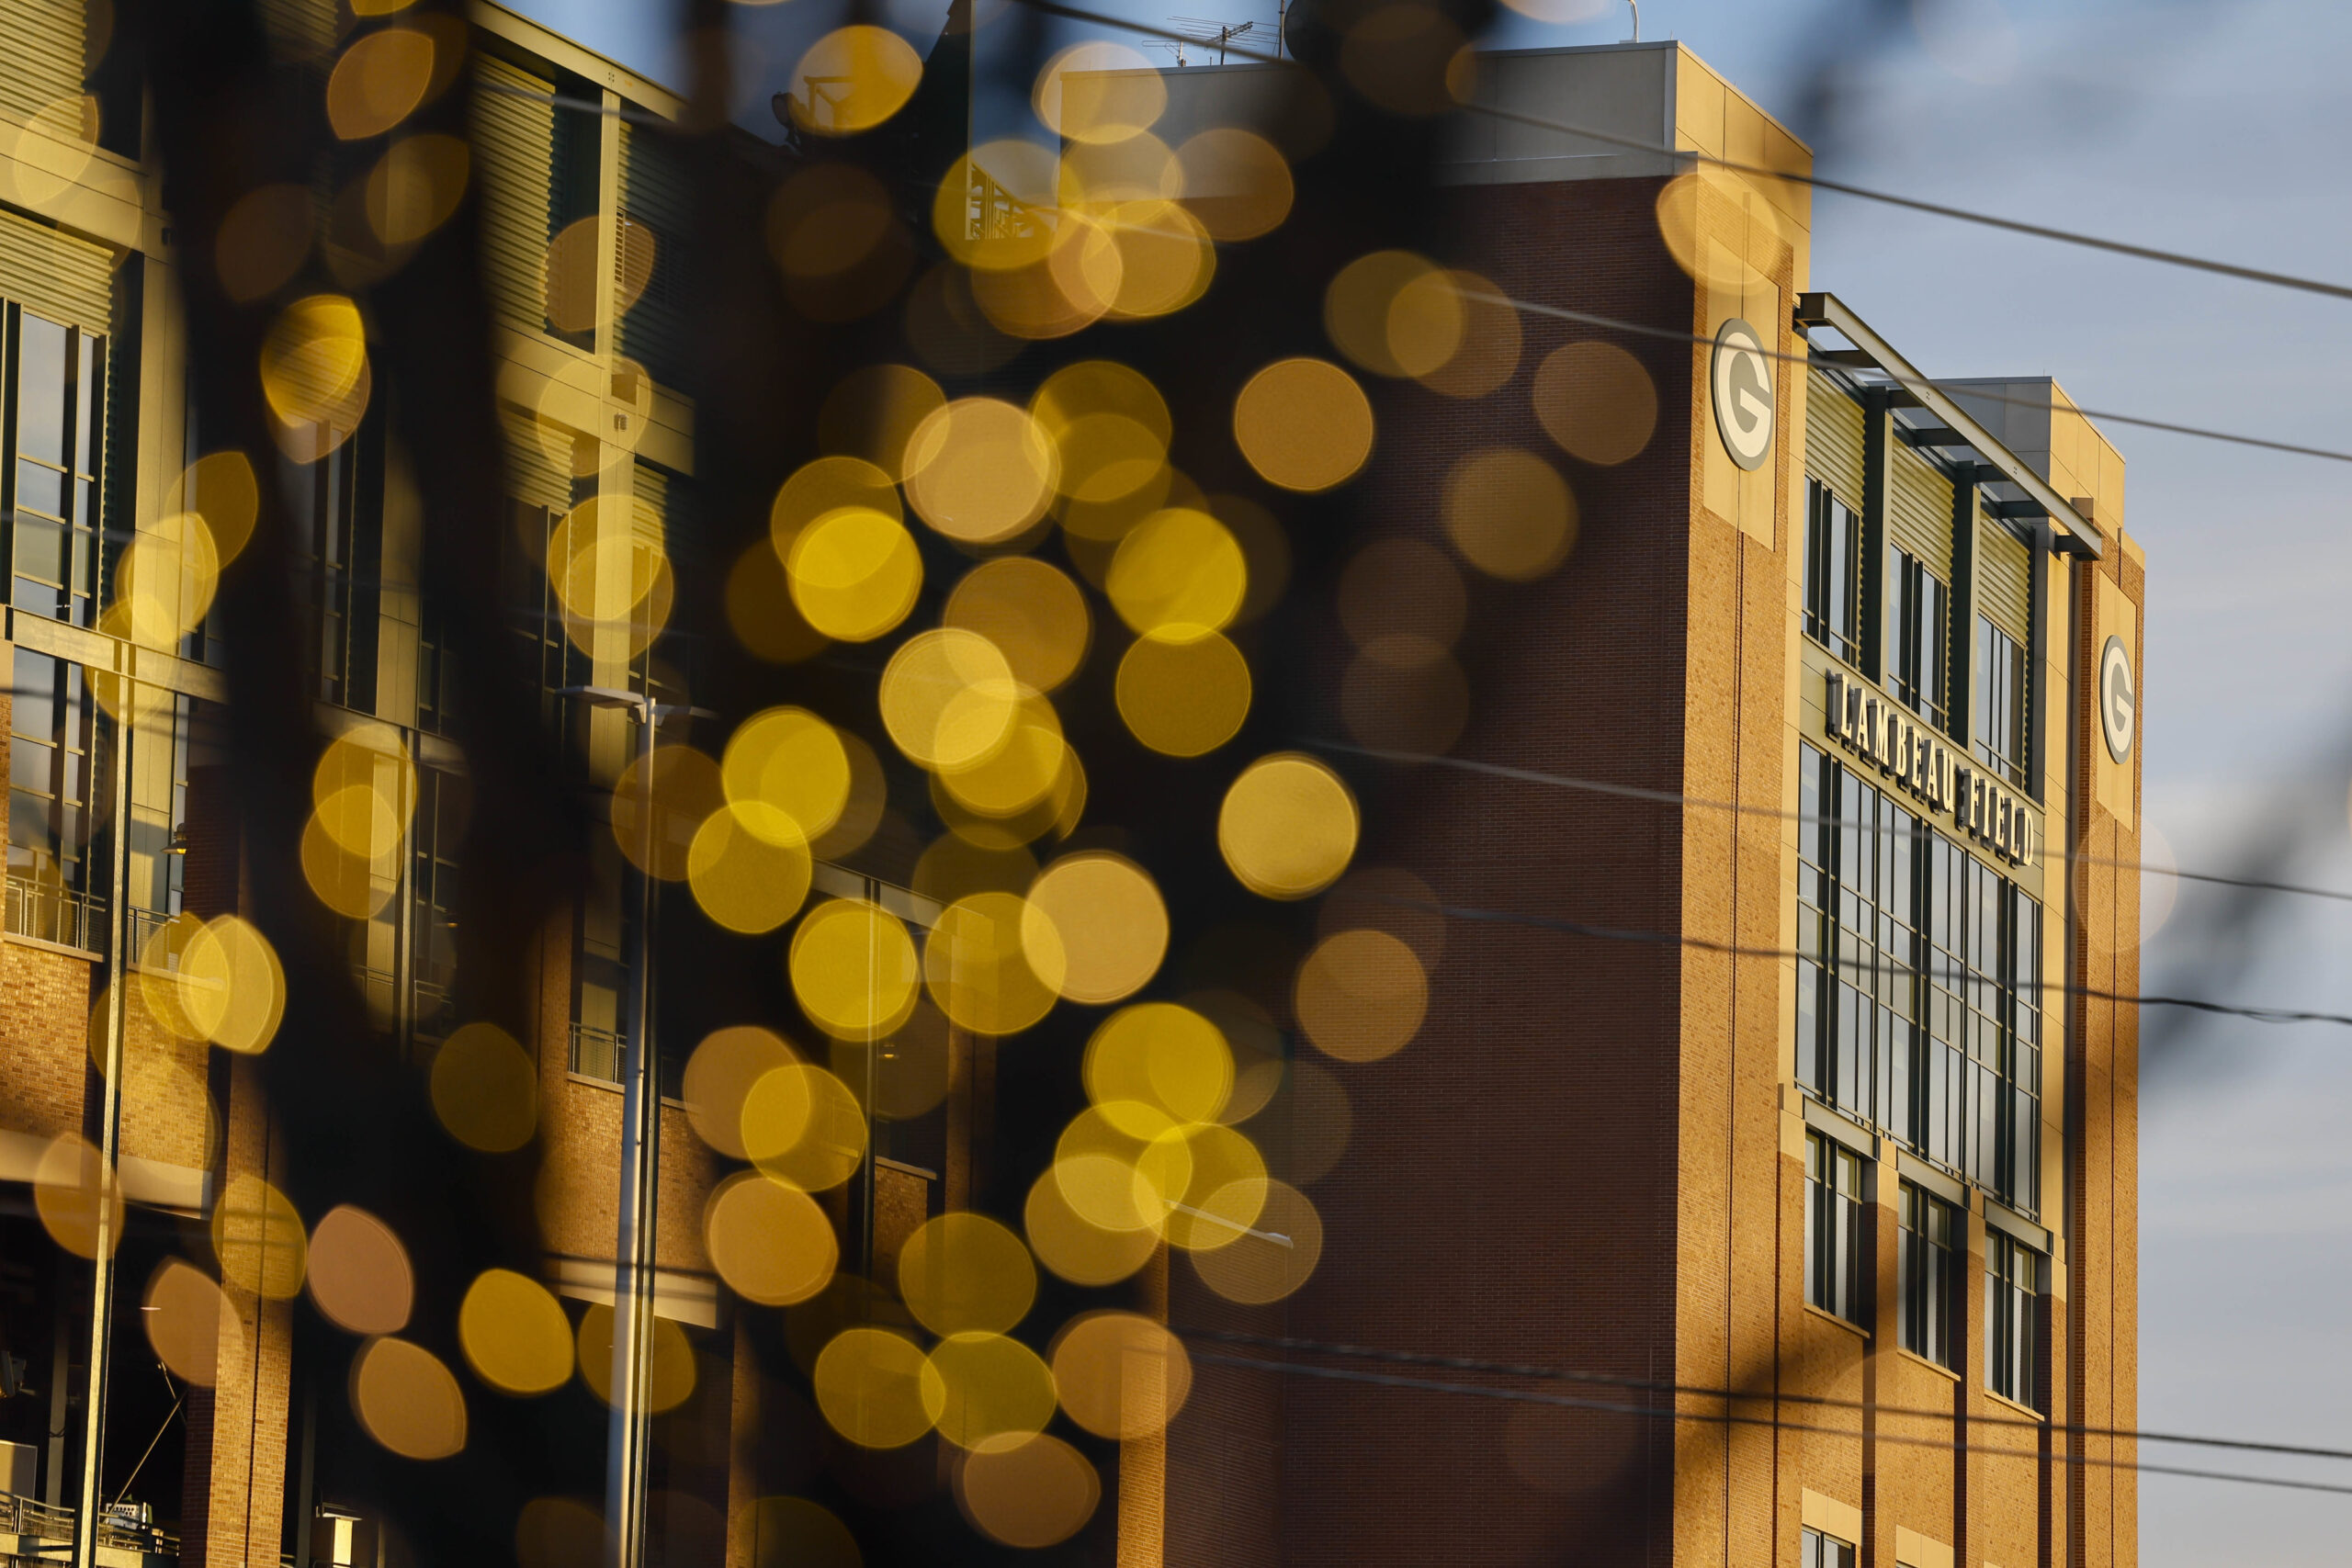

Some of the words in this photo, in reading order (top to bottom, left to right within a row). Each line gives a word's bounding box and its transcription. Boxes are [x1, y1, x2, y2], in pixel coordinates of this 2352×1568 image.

[1718, 332, 1771, 457] G
[2105, 646, 2133, 752] G
[1835, 672, 1954, 814] LAMBEAU
[1963, 769, 2034, 866] FIELD
